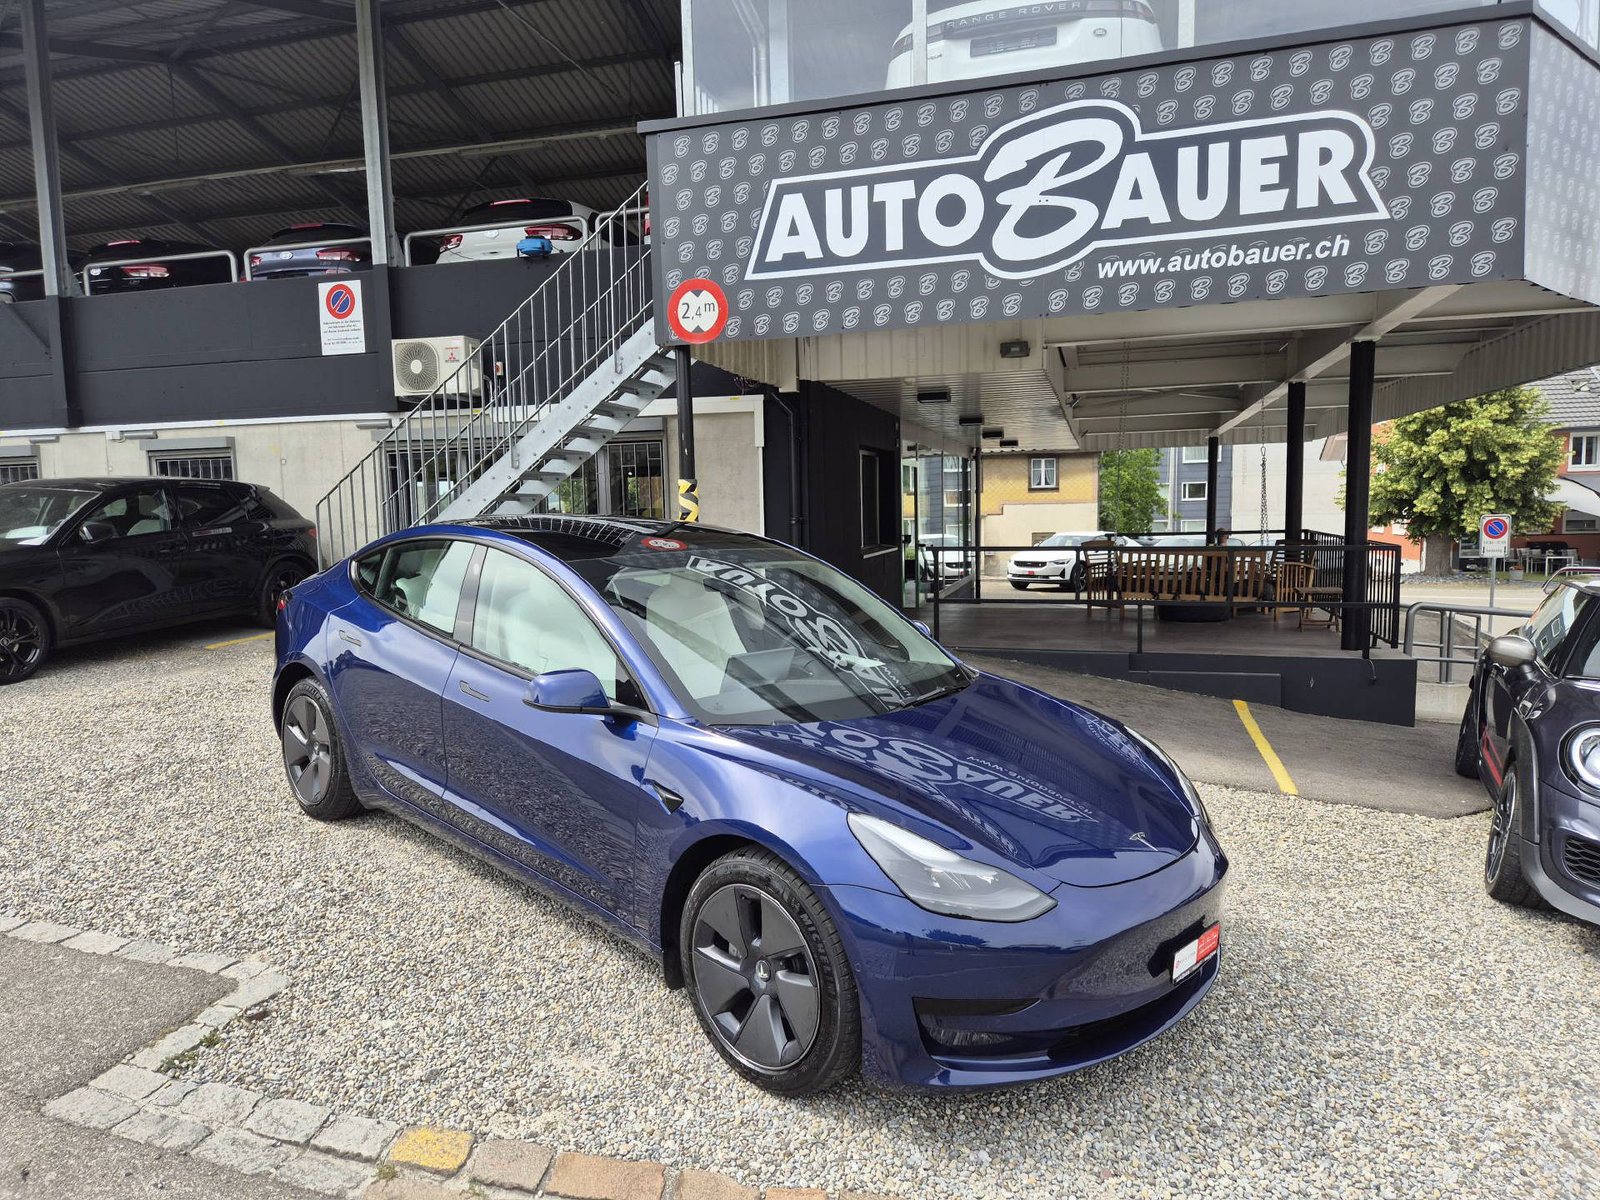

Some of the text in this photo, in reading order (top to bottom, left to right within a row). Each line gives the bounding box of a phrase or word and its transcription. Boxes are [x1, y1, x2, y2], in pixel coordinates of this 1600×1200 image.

[946, 2, 1082, 28] RANGE ROVER
[1411, 34, 1436, 60] B
[1455, 28, 1480, 55] B
[1498, 23, 1524, 49] B
[1289, 51, 1313, 77] B
[1329, 45, 1353, 71] B
[1369, 40, 1394, 66] B
[1174, 66, 1196, 92] B
[1212, 61, 1234, 87] B
[1250, 56, 1273, 81] B
[1434, 62, 1459, 90] B
[1477, 57, 1502, 84] B
[1137, 72, 1159, 98] B
[1310, 79, 1334, 105] B
[1350, 74, 1374, 100] B
[1390, 68, 1416, 95] B
[984, 94, 1004, 118] B
[1193, 95, 1216, 120] B
[1231, 89, 1254, 115] B
[1270, 84, 1294, 110] B
[1453, 93, 1478, 120] B
[1496, 88, 1520, 115] B
[884, 107, 903, 131] B
[917, 103, 936, 127] B
[949, 99, 969, 122] B
[1156, 100, 1178, 125] B
[1368, 103, 1392, 130] B
[1409, 98, 1434, 124] B
[761, 122, 779, 147] B
[791, 120, 809, 143] B
[821, 114, 840, 140] B
[853, 112, 872, 135] B
[1475, 122, 1500, 149] B
[674, 135, 690, 159] B
[702, 131, 720, 154] B
[731, 127, 749, 150] B
[870, 138, 889, 161] B
[902, 134, 921, 158] B
[935, 129, 954, 153] B
[1389, 132, 1414, 159] B
[1432, 127, 1458, 154] B
[748, 153, 766, 176] B
[778, 149, 796, 172] B
[808, 146, 826, 169] B
[840, 141, 858, 165] B
[661, 163, 679, 185] B
[690, 160, 707, 182] B
[719, 157, 737, 179] B
[1407, 161, 1432, 188] B
[1451, 158, 1476, 183] B
[1493, 153, 1519, 180] B
[676, 189, 693, 211] B
[704, 185, 721, 208] B
[733, 182, 751, 204] B
[764, 117, 1358, 263] AUTO BAUER
[1472, 187, 1498, 213] B
[1430, 191, 1455, 218] B
[664, 217, 680, 239] B
[692, 214, 709, 236] B
[720, 211, 738, 233] B
[1449, 220, 1474, 247] B
[1491, 217, 1517, 243] B
[706, 239, 723, 260] B
[1364, 229, 1389, 255] B
[1405, 225, 1430, 251] B
[678, 241, 695, 263] B
[1098, 234, 1350, 279] www.autobauer.ch
[1471, 251, 1496, 277] B
[722, 263, 740, 285] B
[1304, 265, 1328, 291] B
[1344, 261, 1368, 287] B
[1385, 258, 1409, 283] B
[1428, 254, 1453, 280] B
[826, 281, 844, 303] B
[856, 279, 875, 300] B
[887, 276, 906, 298] B
[919, 273, 938, 295] B
[951, 270, 970, 293] B
[1118, 281, 1139, 306] B
[1154, 279, 1175, 303] B
[1190, 276, 1212, 300] B
[1227, 273, 1250, 297] B
[1265, 269, 1288, 294] B
[737, 289, 754, 310] B
[765, 286, 784, 308] B
[796, 283, 814, 305] B
[1002, 293, 1022, 316] B
[1048, 289, 1068, 312] B
[1082, 285, 1103, 309] B
[812, 309, 830, 330] B
[842, 306, 860, 328] B
[873, 304, 892, 326] B
[904, 301, 923, 324] B
[936, 299, 955, 321] B
[970, 296, 989, 319] B
[723, 316, 741, 336] B
[754, 314, 771, 334] B
[782, 311, 800, 332] B
